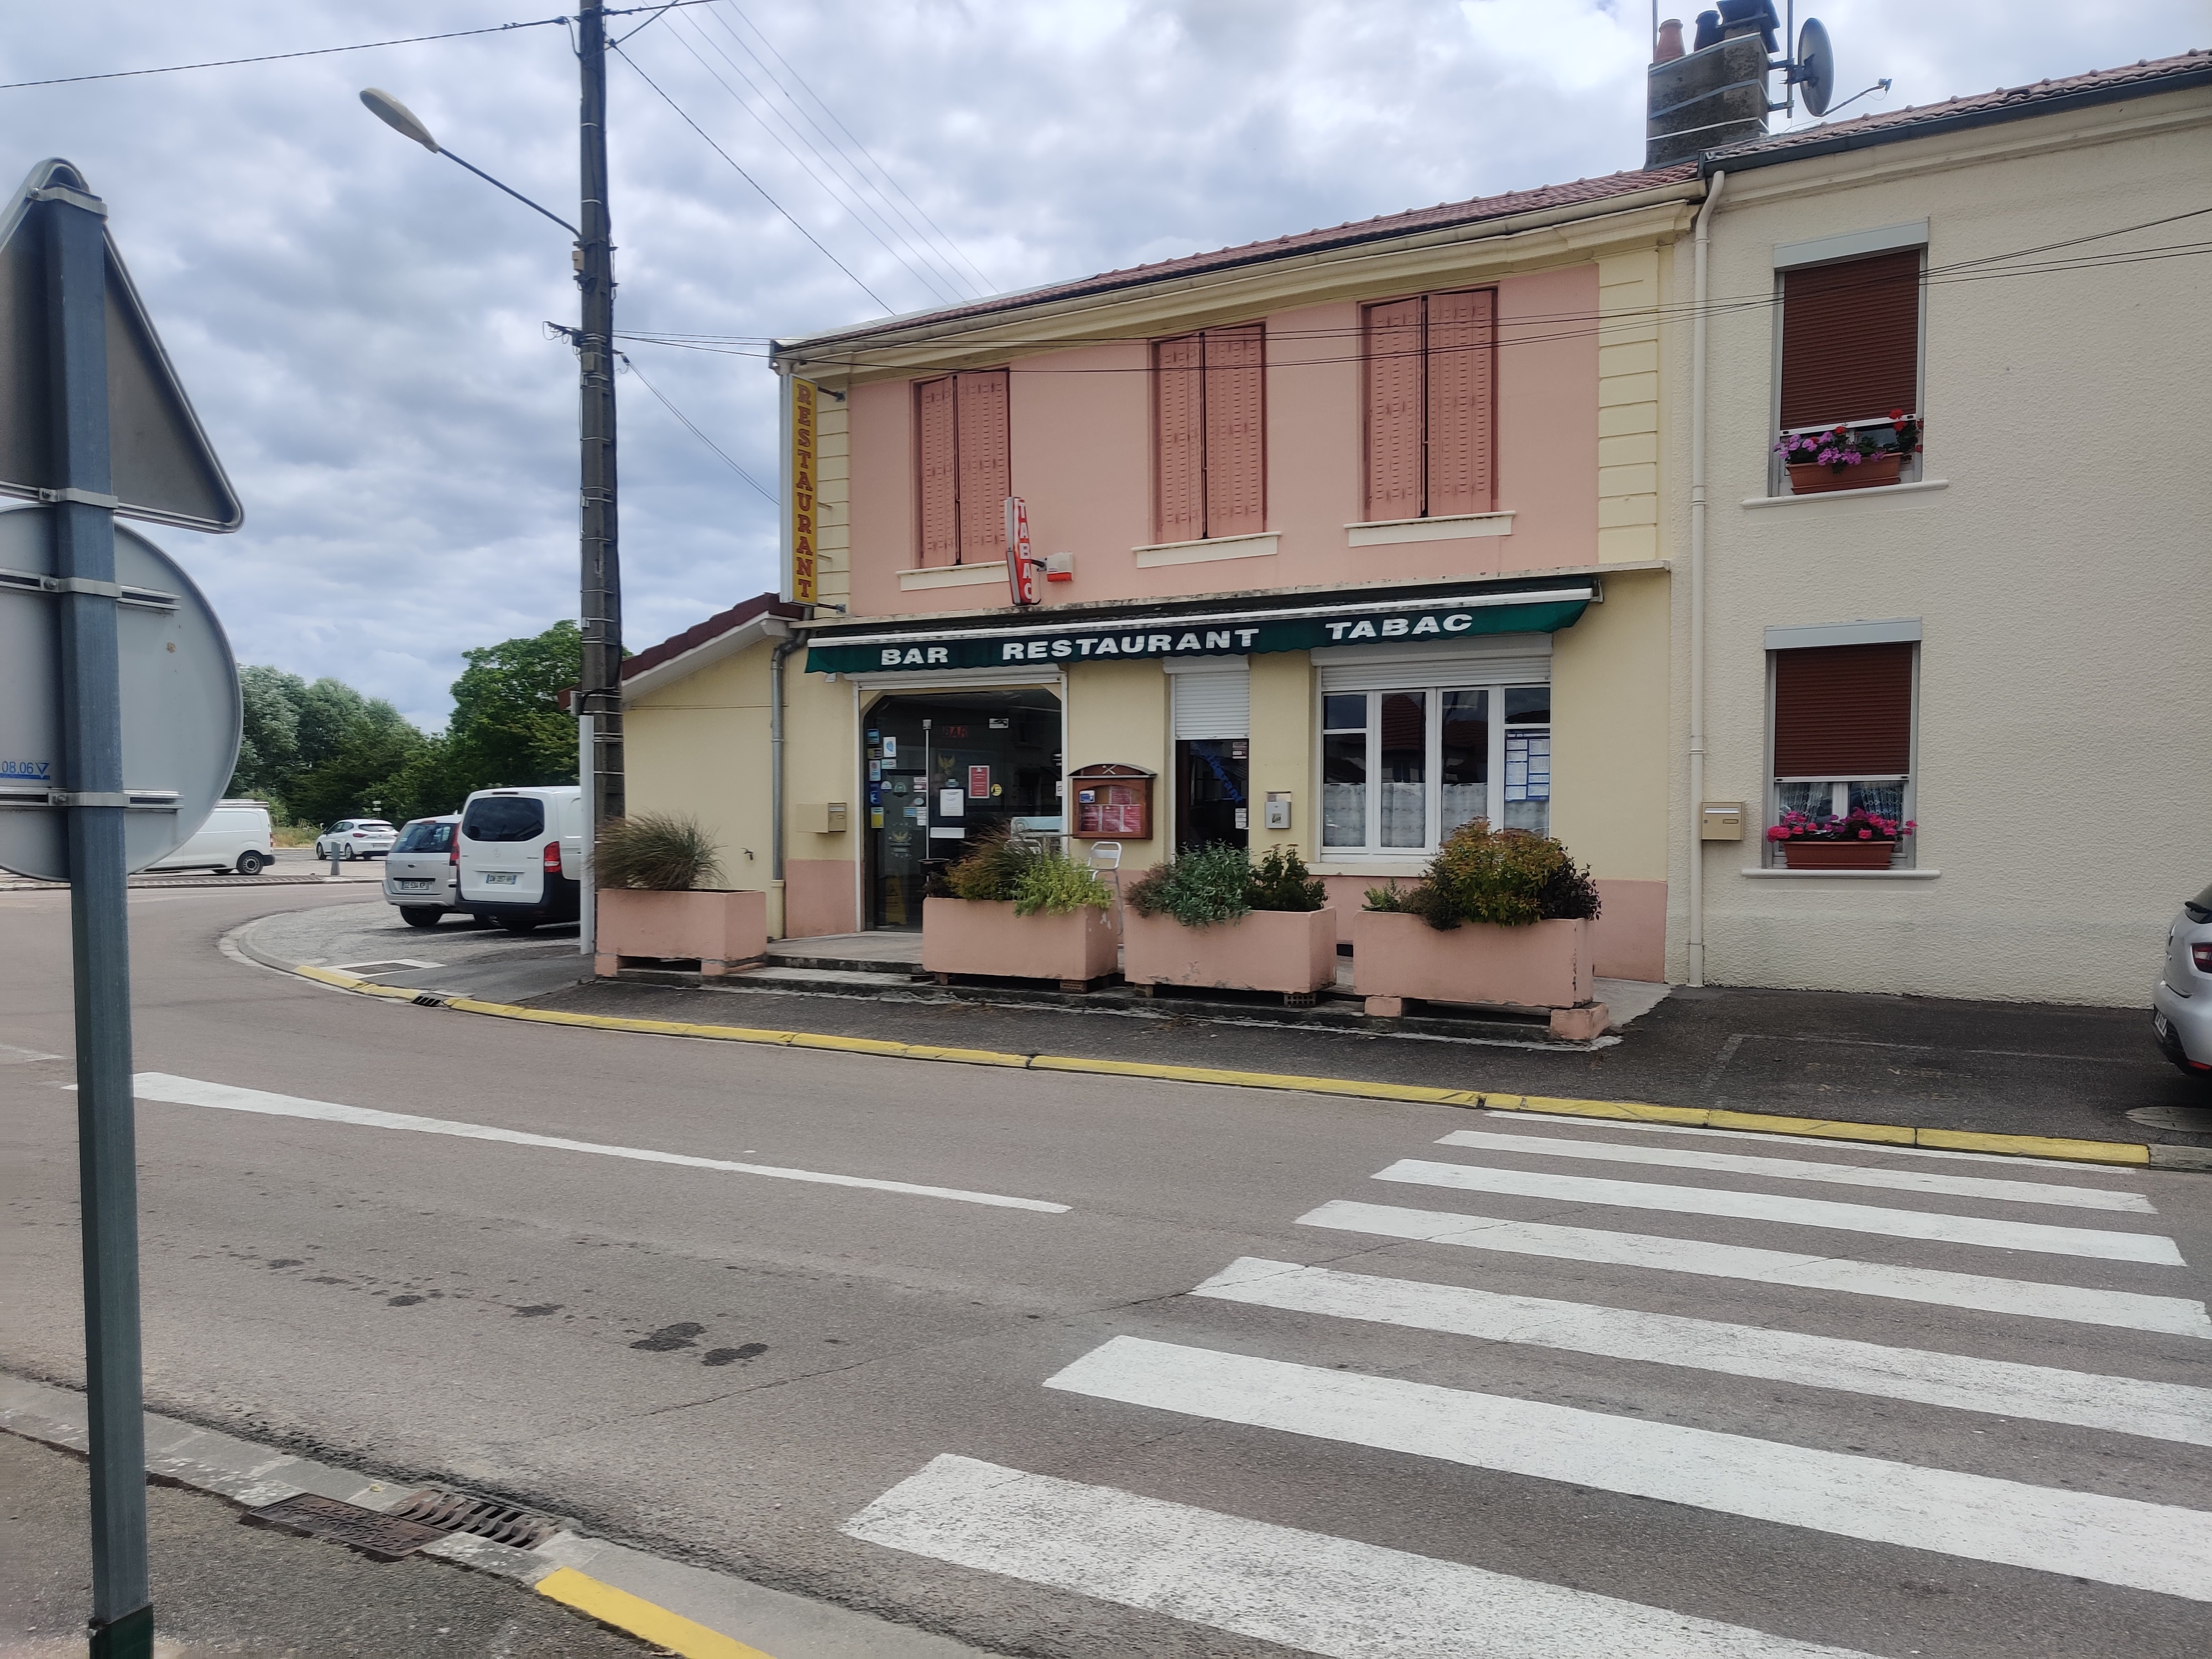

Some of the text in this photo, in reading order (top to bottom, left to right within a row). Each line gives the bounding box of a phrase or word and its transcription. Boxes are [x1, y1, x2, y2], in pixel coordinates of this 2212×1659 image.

[796, 383, 813, 598] RESTAURANT
[1018, 502, 1032, 599] TABAC
[881, 614, 1473, 665] BAR RESTAURANT TABAC
